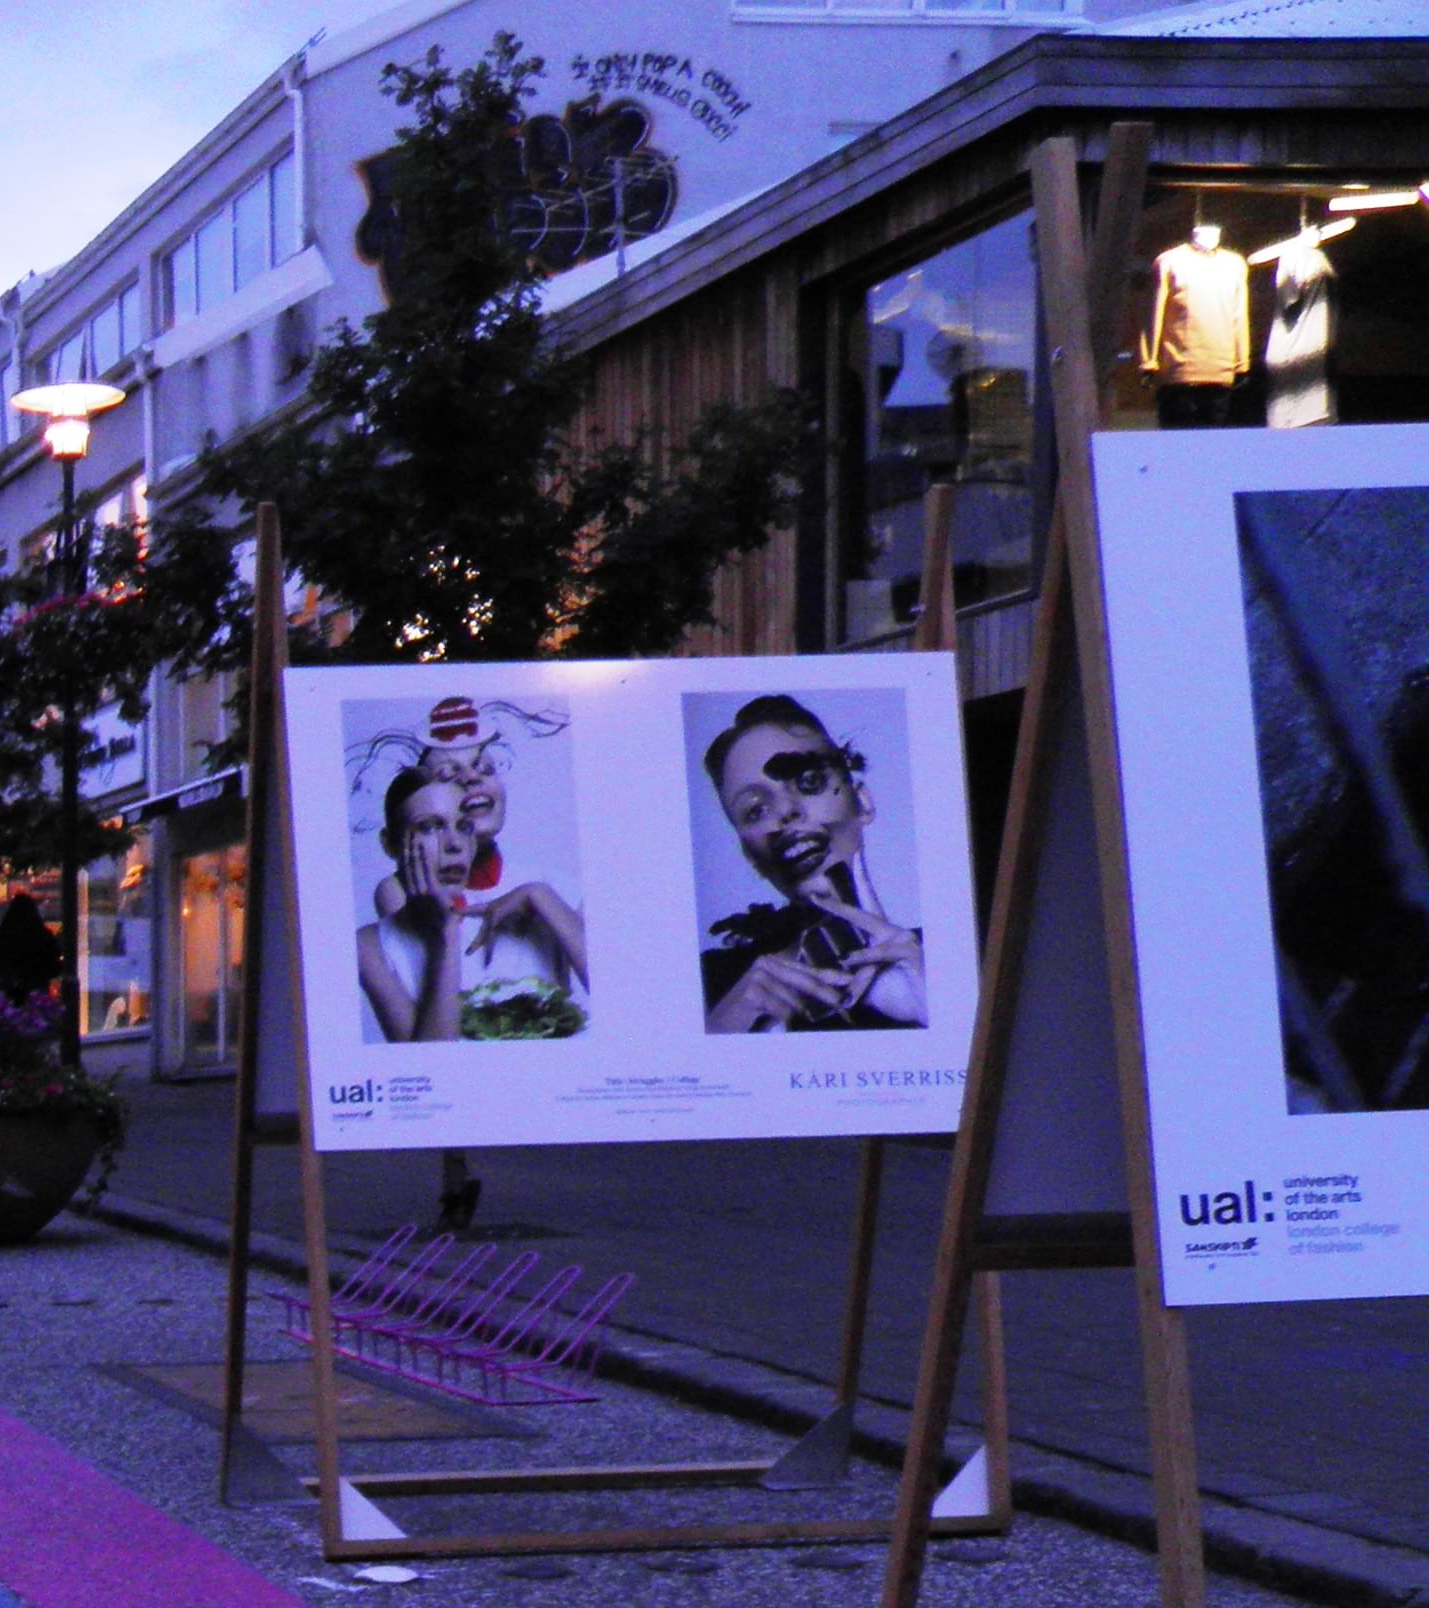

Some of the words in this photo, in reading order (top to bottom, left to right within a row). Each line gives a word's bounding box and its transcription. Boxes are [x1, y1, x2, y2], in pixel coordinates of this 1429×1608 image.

[642, 53, 678, 75] POP
[676, 59, 693, 79] A
[329, 1079, 384, 1104] ual:
[1283, 1173, 1360, 1189] university
[1180, 1180, 1275, 1226] ual:
[1284, 1193, 1301, 1206] of
[1303, 1192, 1329, 1205] the
[1331, 1189, 1363, 1203] arts
[1286, 1208, 1340, 1222] london
